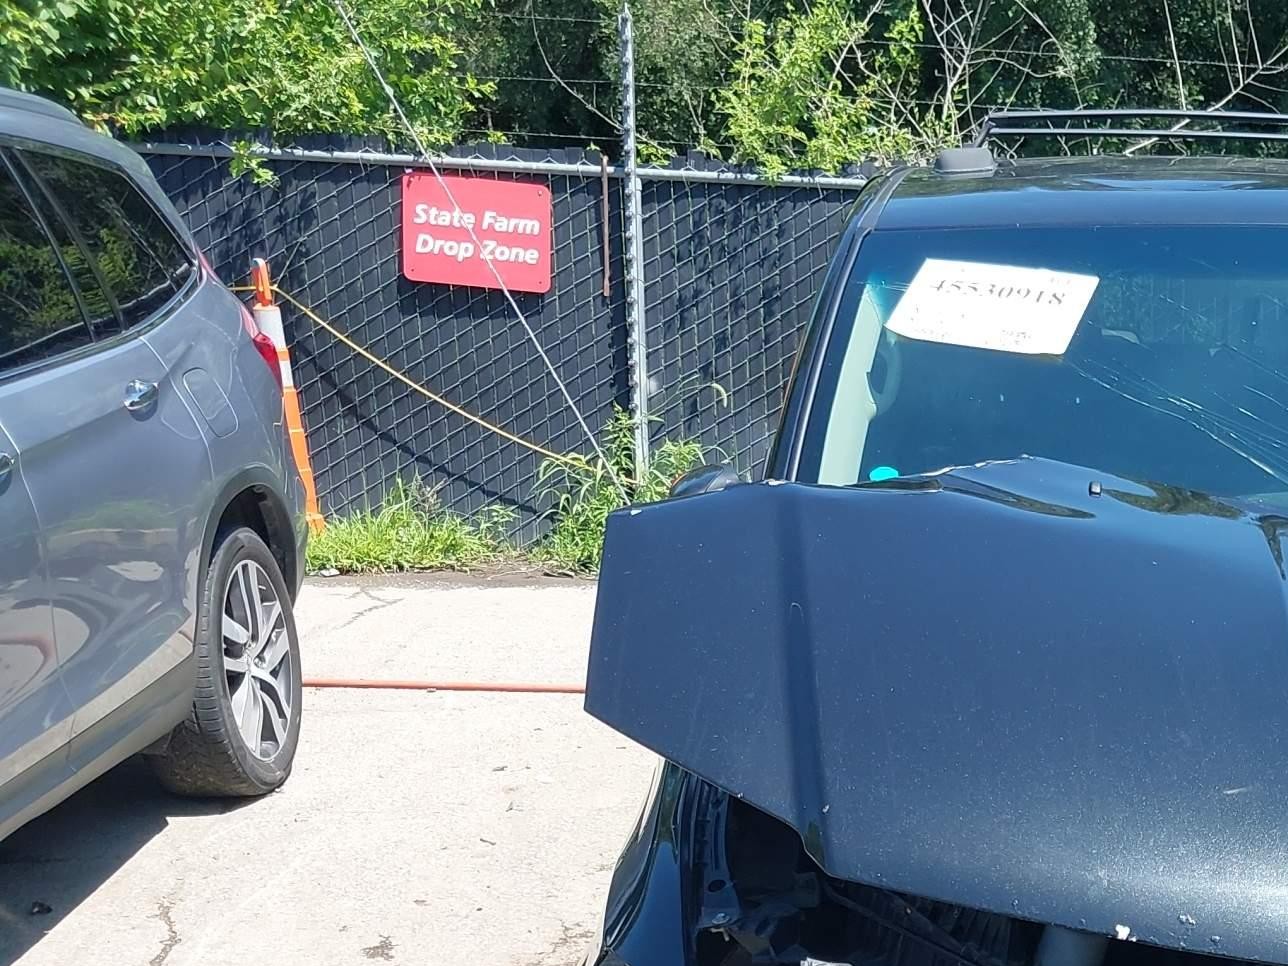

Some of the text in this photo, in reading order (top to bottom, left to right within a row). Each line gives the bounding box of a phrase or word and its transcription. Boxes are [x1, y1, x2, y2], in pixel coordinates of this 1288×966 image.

[413, 203, 541, 235] State Farm
[415, 233, 540, 265] Drop Zone
[930, 277, 1067, 306] 45530918
